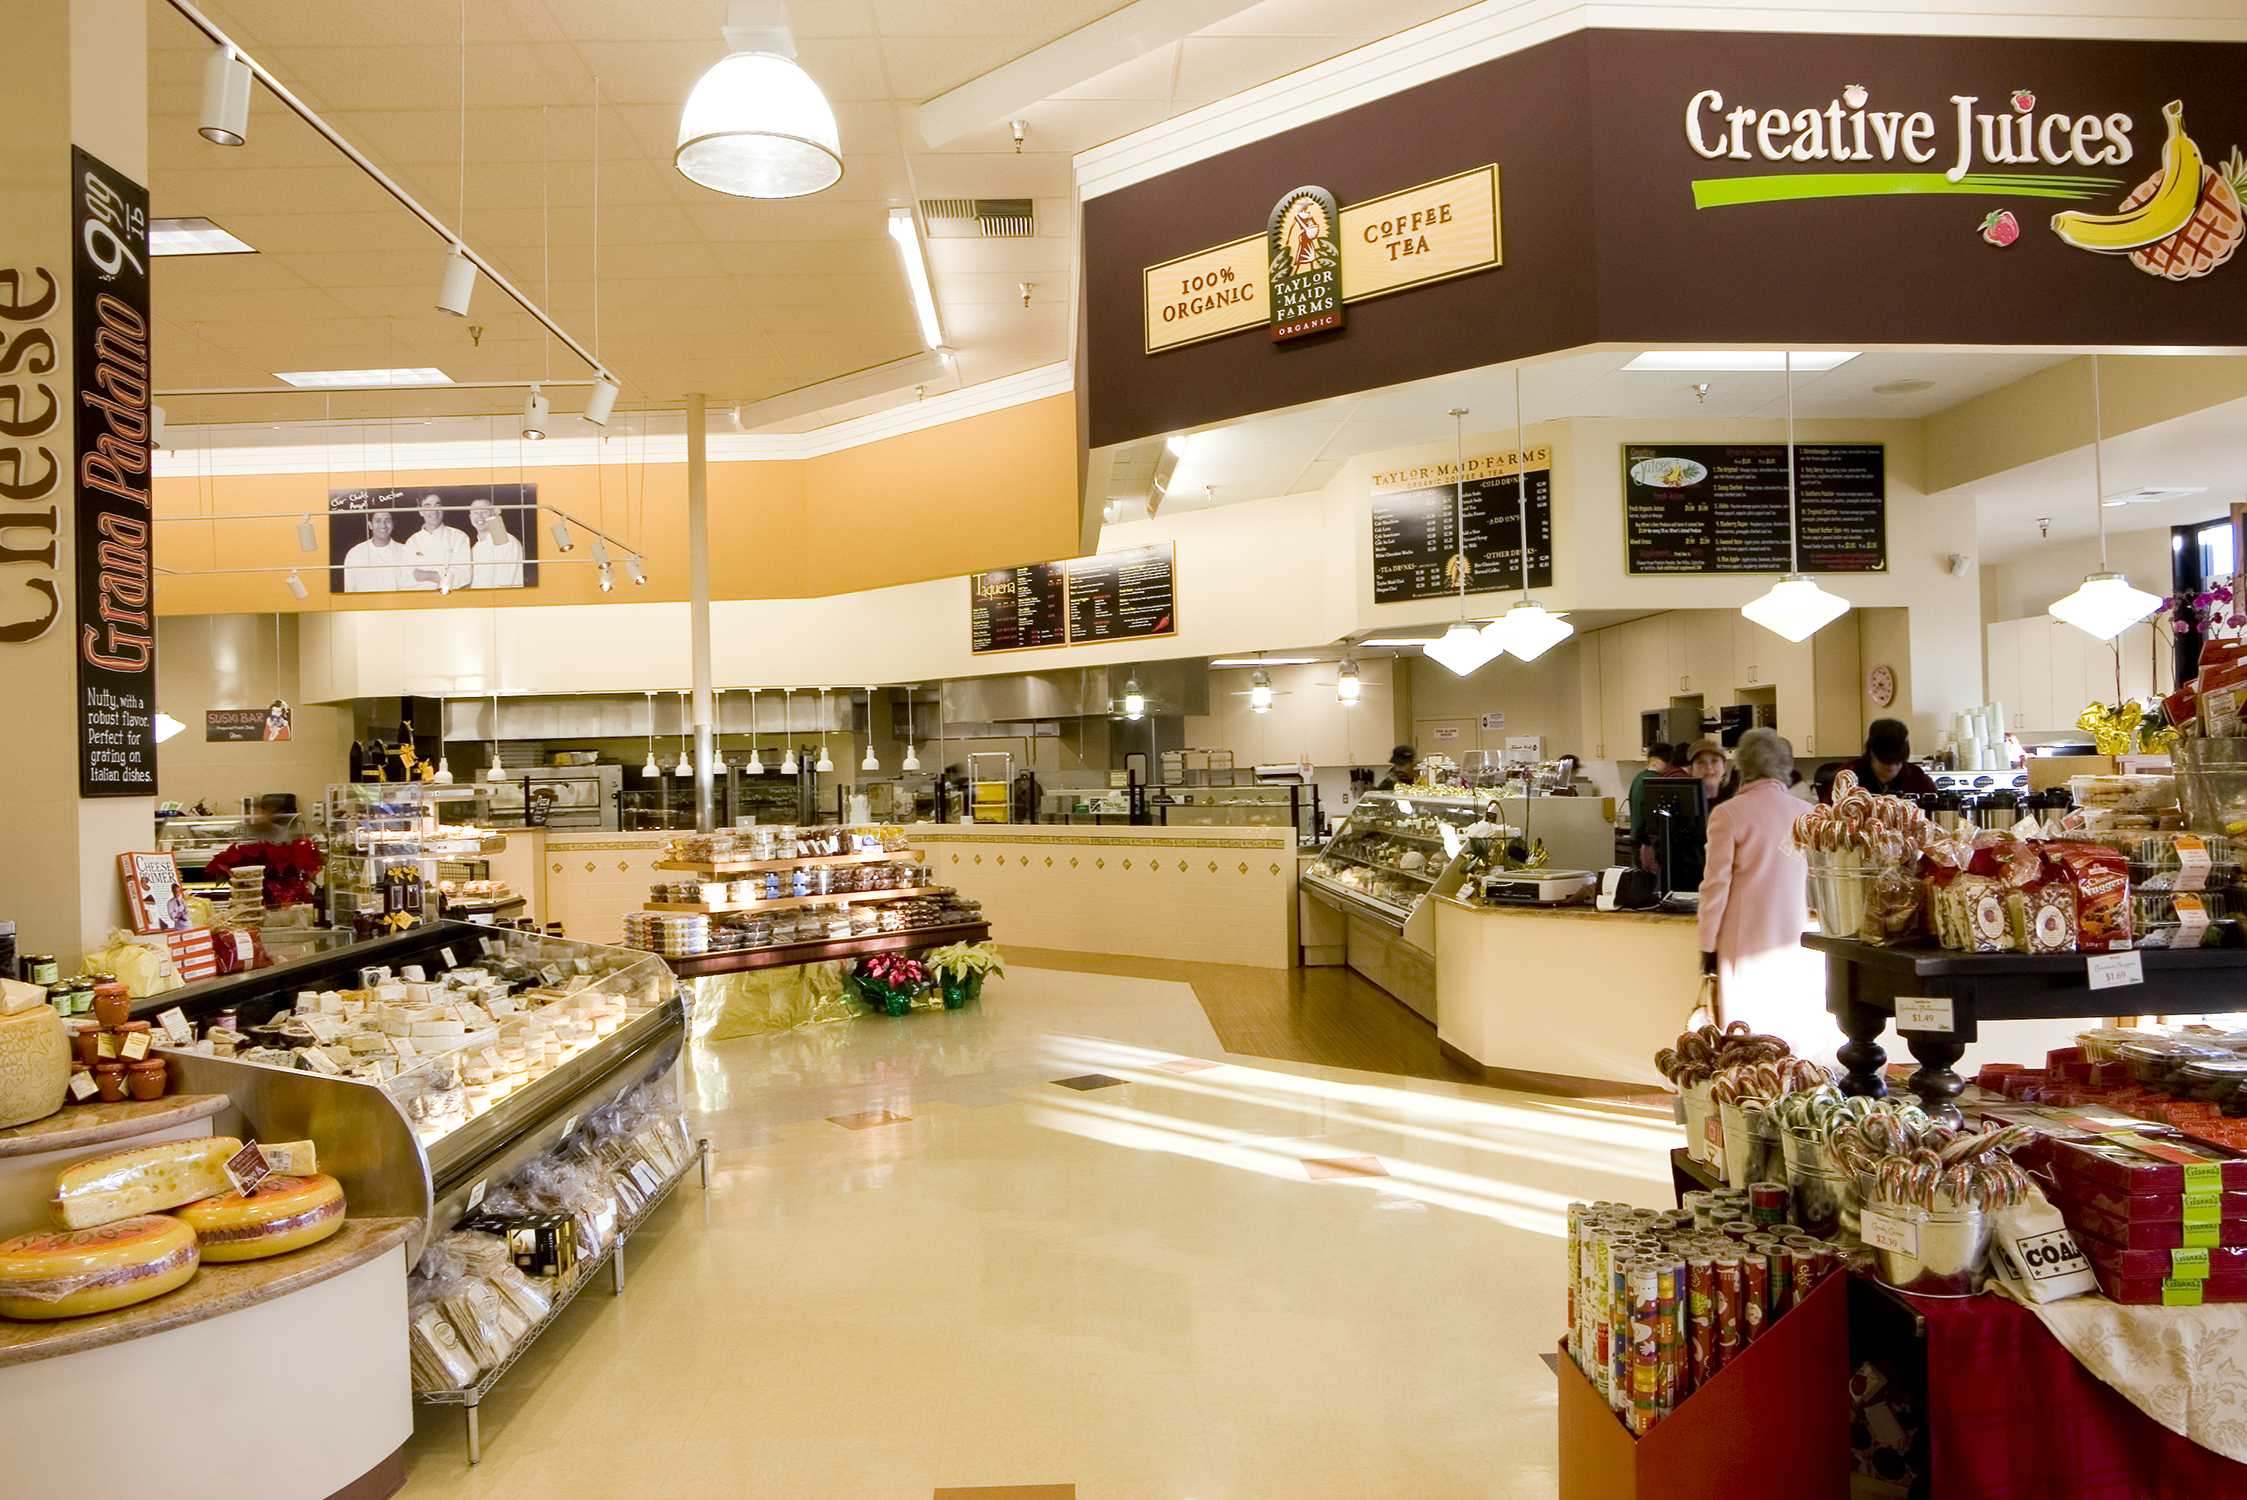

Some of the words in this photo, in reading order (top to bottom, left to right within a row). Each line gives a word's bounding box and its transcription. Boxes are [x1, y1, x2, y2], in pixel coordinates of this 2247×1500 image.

[1686, 86, 1936, 165] Creative
[1944, 89, 2134, 184] Juices
[1363, 203, 1453, 244] COFFEE
[1386, 237, 1431, 261] TEA
[1181, 266, 1235, 295] 100%
[1275, 271, 1333, 295] TAYLOR
[1162, 283, 1255, 322] ORGANIC
[1277, 297, 1333, 321] FARMS
[1279, 317, 1332, 335] ORGANIC
[81, 293, 152, 510] Padano
[1372, 467, 1429, 487] TAYLOR
[1486, 449, 1547, 469] FARMS
[83, 512, 153, 674] Grana
[87, 687, 120, 711] Nutty,
[120, 694, 138, 708] with
[139, 698, 144, 709] a
[88, 710, 119, 726] robust
[122, 711, 150, 727] flavor.
[240, 712, 264, 723] BAR
[88, 728, 124, 745] Perfect
[127, 730, 142, 745] for
[90, 748, 127, 767] grating
[129, 751, 142, 763] on
[90, 767, 121, 782] Italian
[122, 766, 153, 782] dishes.
[136, 856, 173, 872] CHEESE
